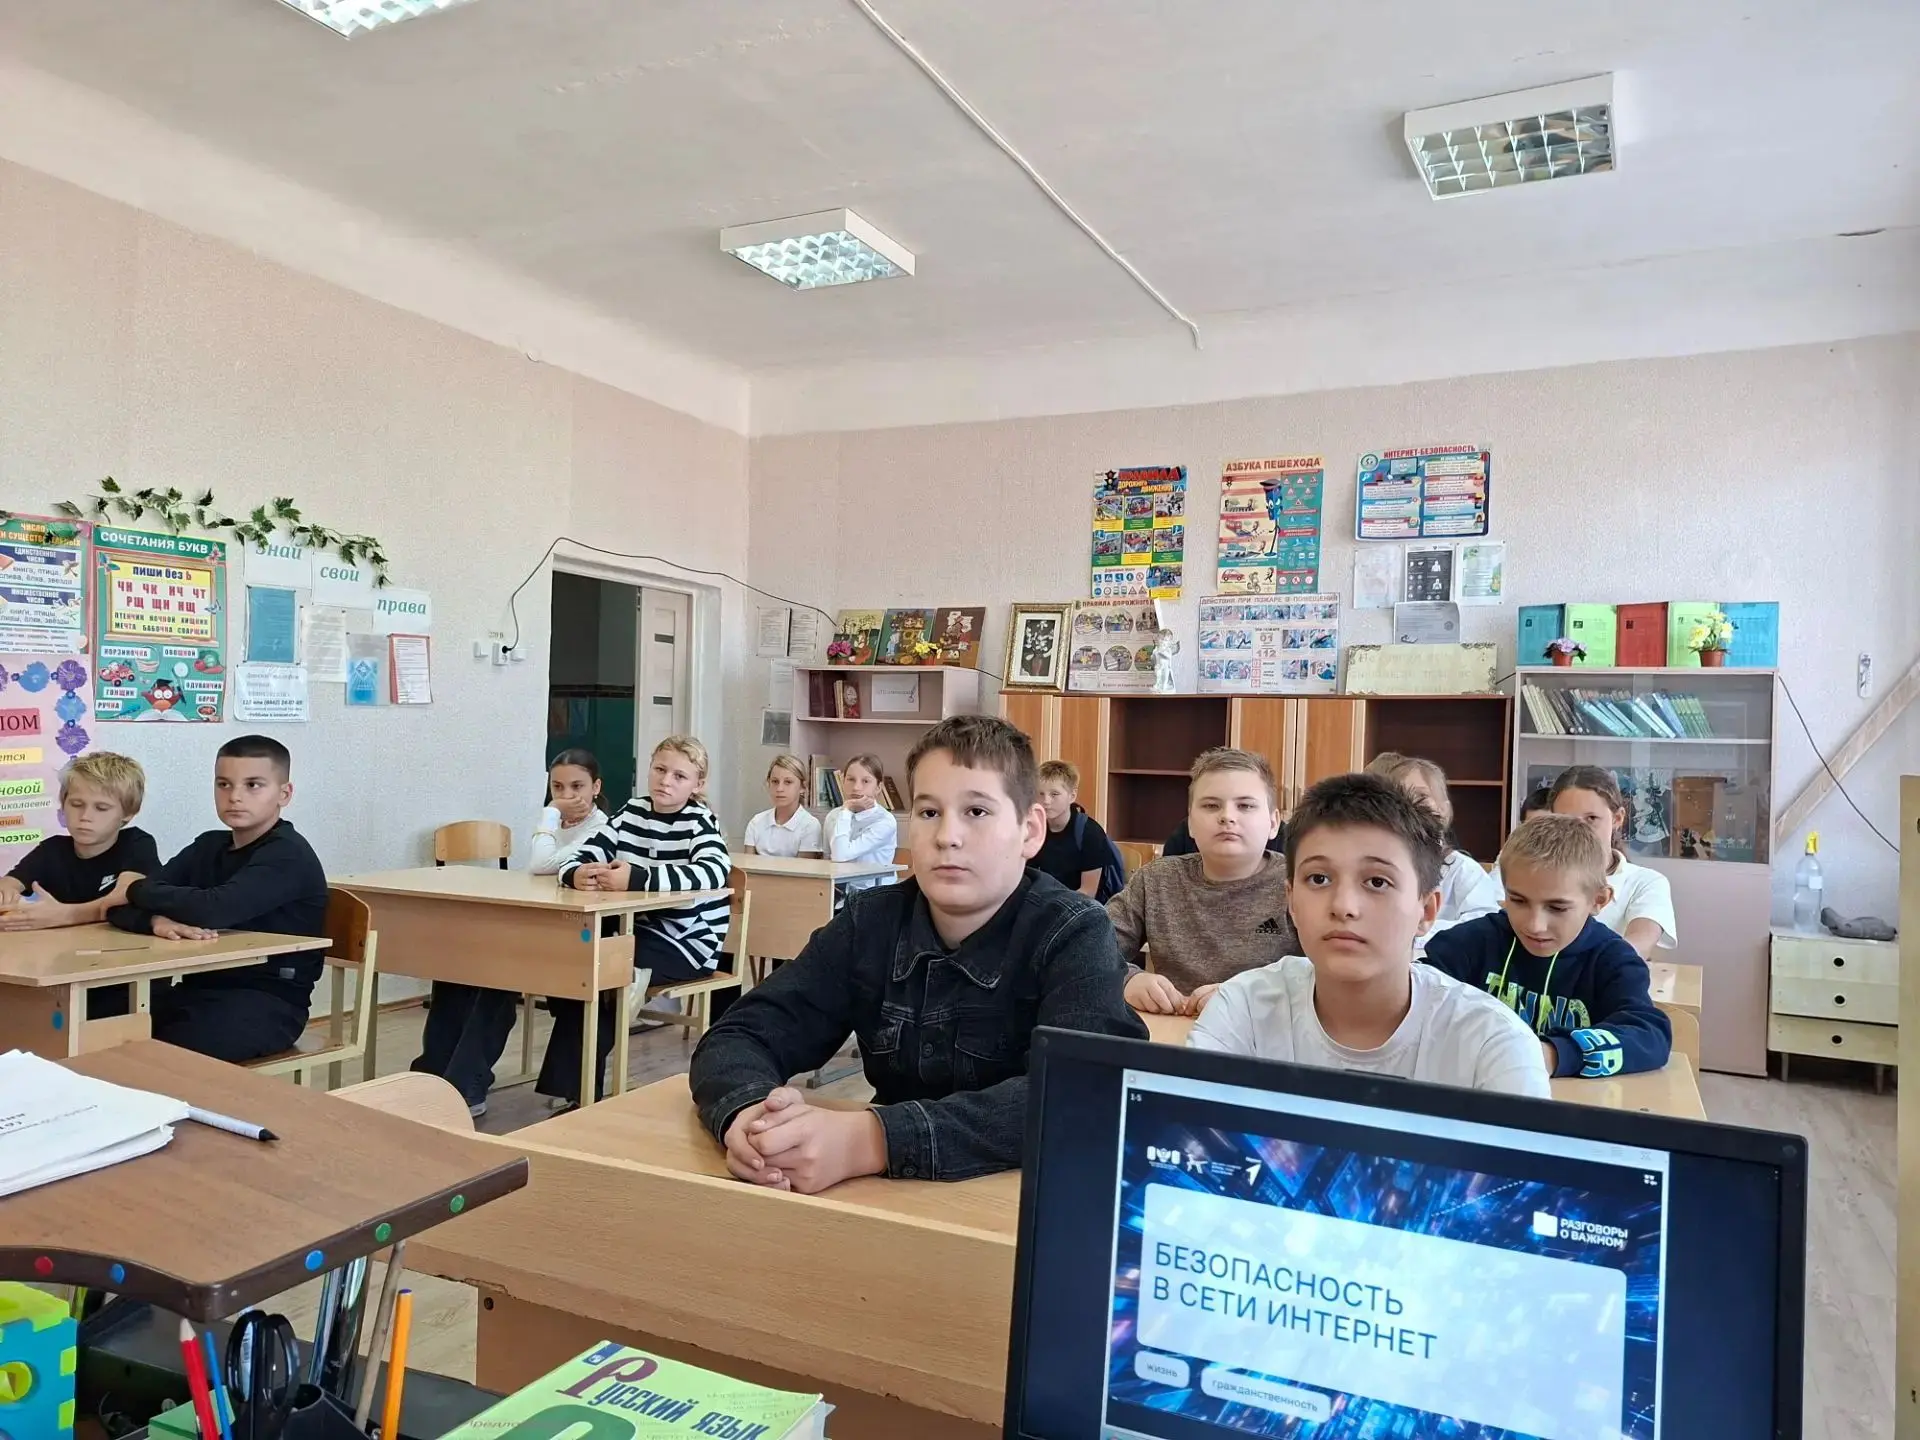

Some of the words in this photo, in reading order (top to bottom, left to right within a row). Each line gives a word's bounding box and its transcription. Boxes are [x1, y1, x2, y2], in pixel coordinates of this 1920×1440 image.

[1383, 444, 1476, 458] ИНТЕРНЕТ-БЕЗОПАСНОСТЬ
[1226, 462, 1261, 471] АЗБУКА
[1264, 458, 1320, 469] ПЕШЕХОДА
[101, 531, 175, 550] СОЧЕТАНИЯ
[178, 541, 208, 554] БУКВ
[133, 566, 162, 579] пиши
[165, 569, 183, 580] без
[320, 566, 360, 582] свои
[118, 581, 133, 592] ЧН
[193, 588, 206, 599] ЧТ
[126, 597, 144, 609] РЩ
[377, 599, 427, 615] права
[115, 622, 137, 630] МЕЧТА
[1560, 1218, 1629, 1239] РАЗГОВОРЫ
[1560, 1230, 1569, 1239] О
[1571, 1232, 1625, 1249] ВАЖНОМ
[1155, 1242, 1404, 1316] БЕЗОПАСНОСТЬ
[1153, 1276, 1169, 1300] В
[1180, 1282, 1257, 1322] СЕТИ
[1267, 1300, 1437, 1360] ИНТЕРНЕТ
[1146, 1363, 1178, 1379] жизнь
[1212, 1379, 1319, 1413] гражданственность
